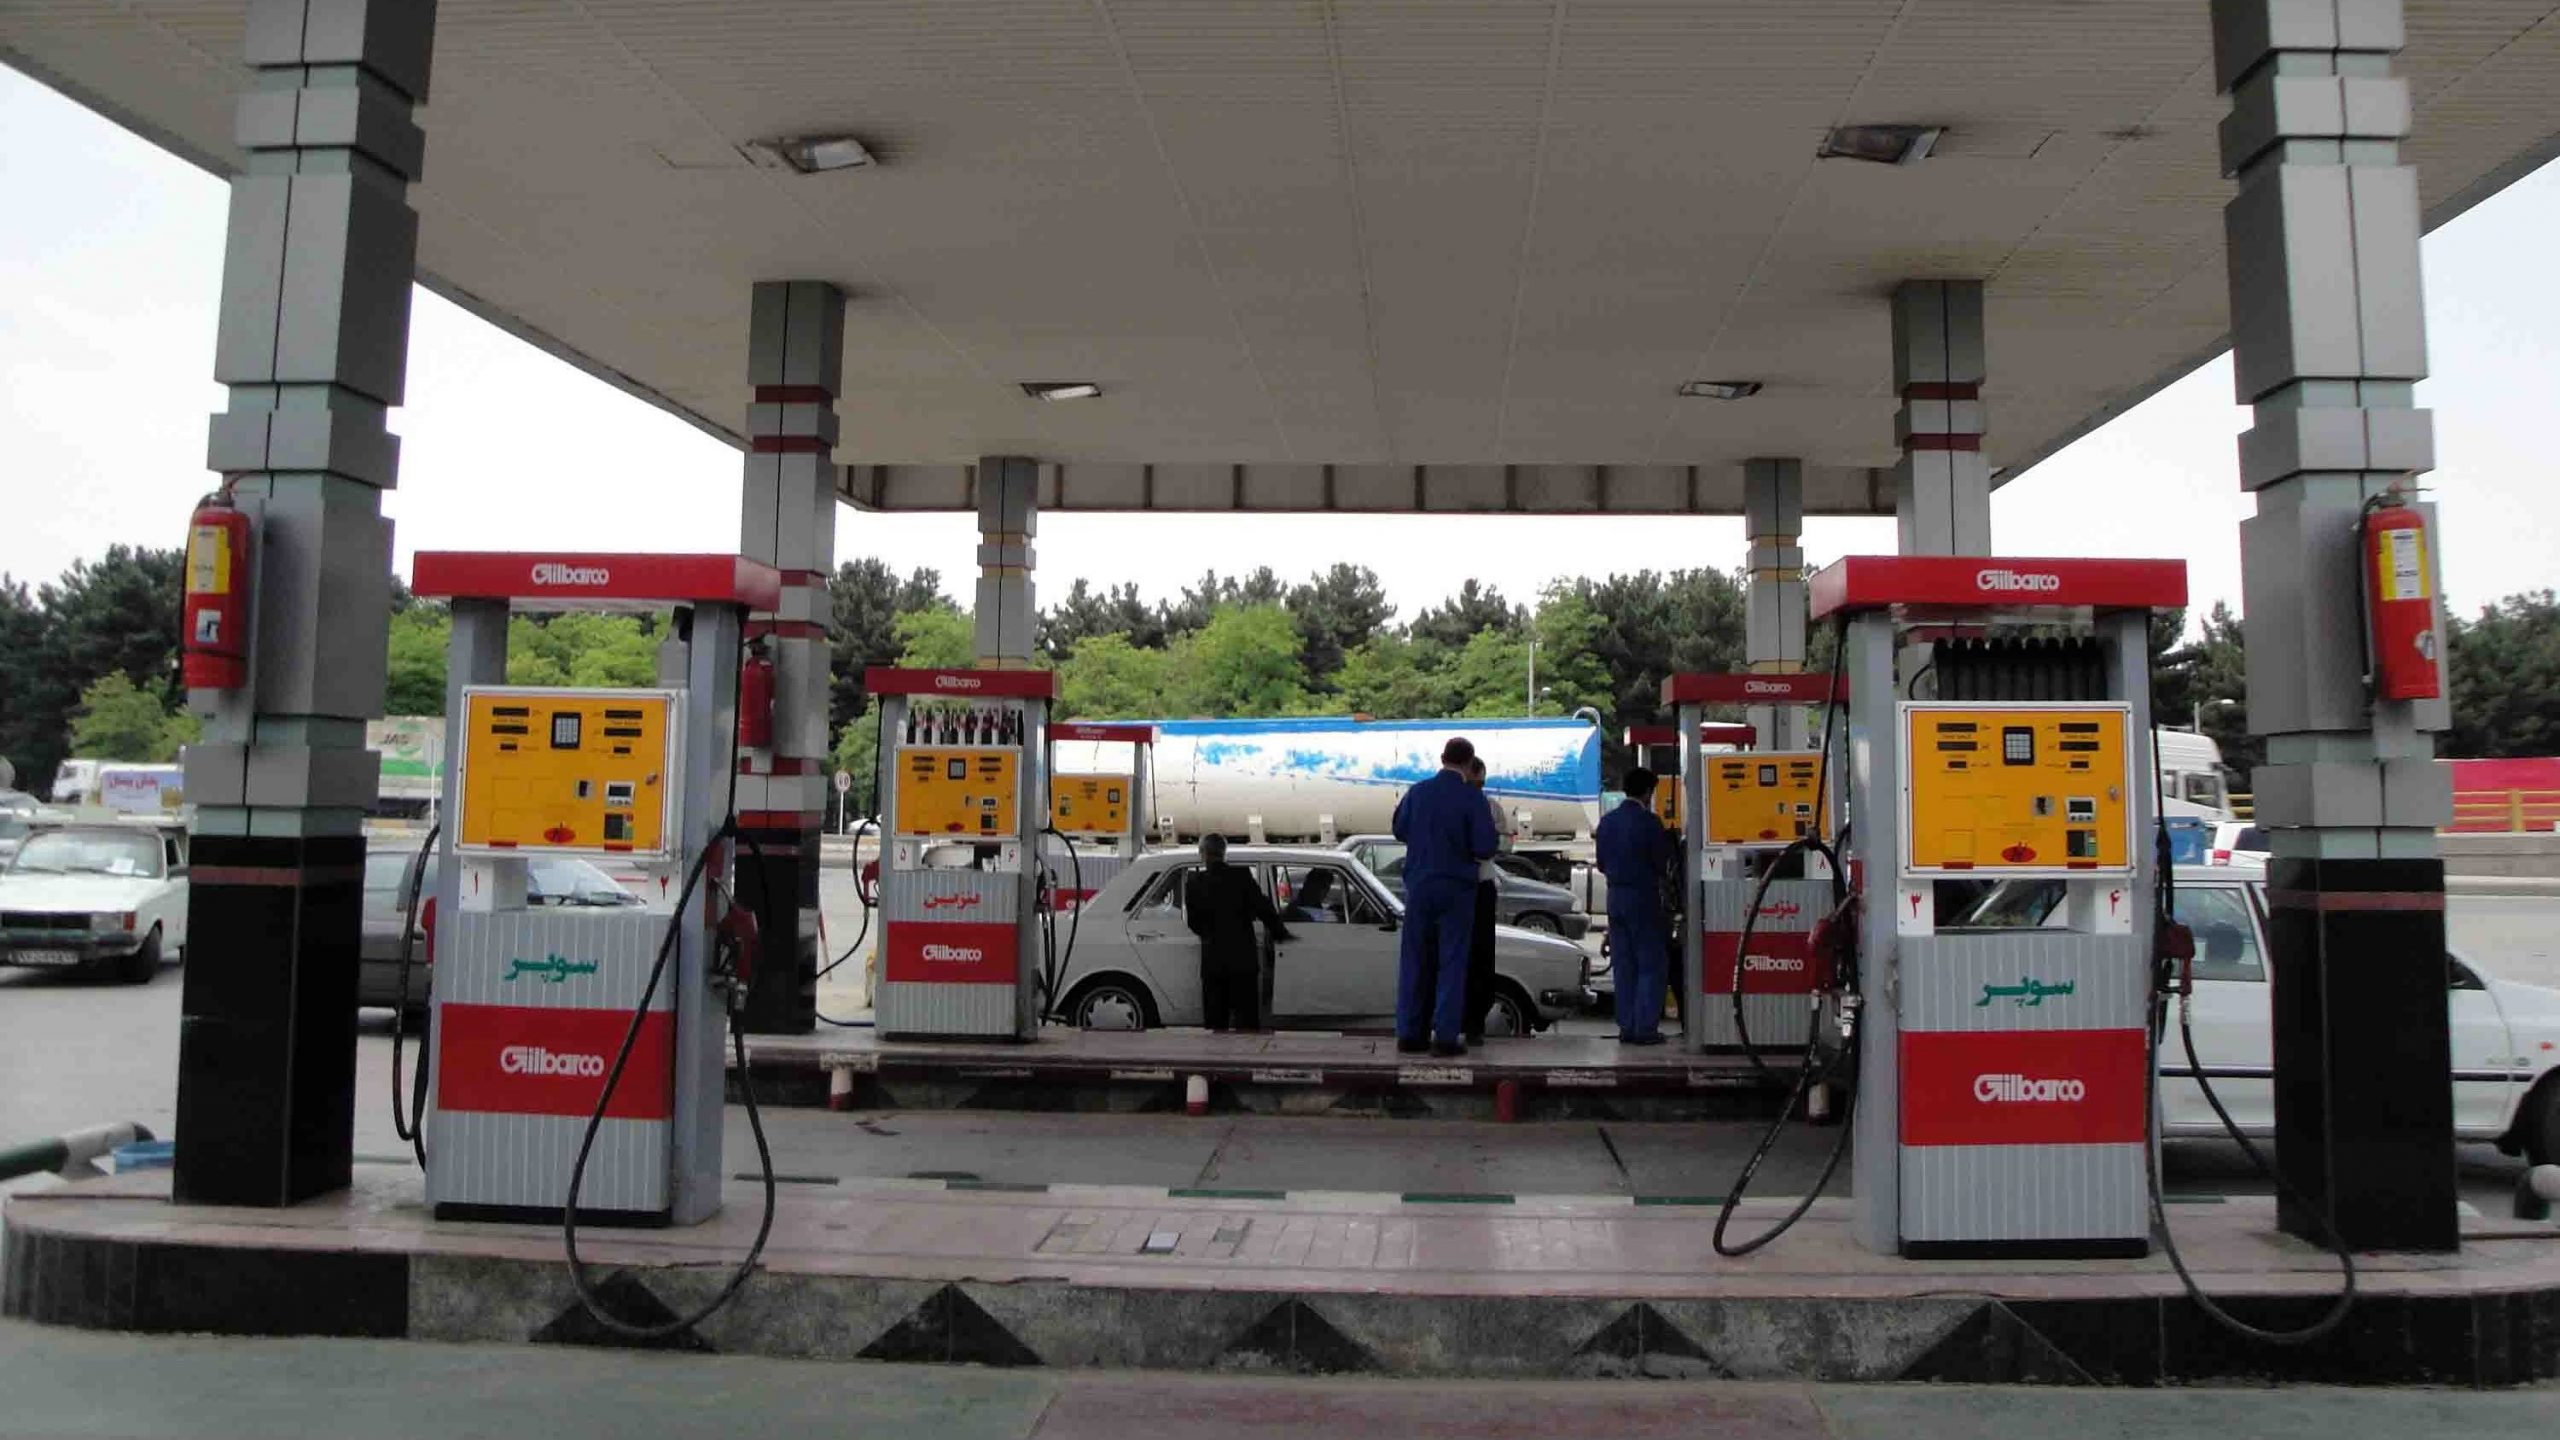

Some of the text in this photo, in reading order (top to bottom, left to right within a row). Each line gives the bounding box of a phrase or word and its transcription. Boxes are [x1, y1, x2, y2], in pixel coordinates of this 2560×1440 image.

[532, 563, 609, 585] Gilbarco
[1977, 569, 2060, 591] Gilbarco
[935, 675, 981, 688] Gilbarco
[922, 944, 982, 961] Gilbarco
[1744, 955, 1804, 971] Gilbarco
[504, 954, 599, 983] سوپر
[1975, 976, 2074, 1007] سوپر
[500, 1045, 604, 1076] Gilbarco
[1974, 1073, 2084, 1102] Gilbarco
